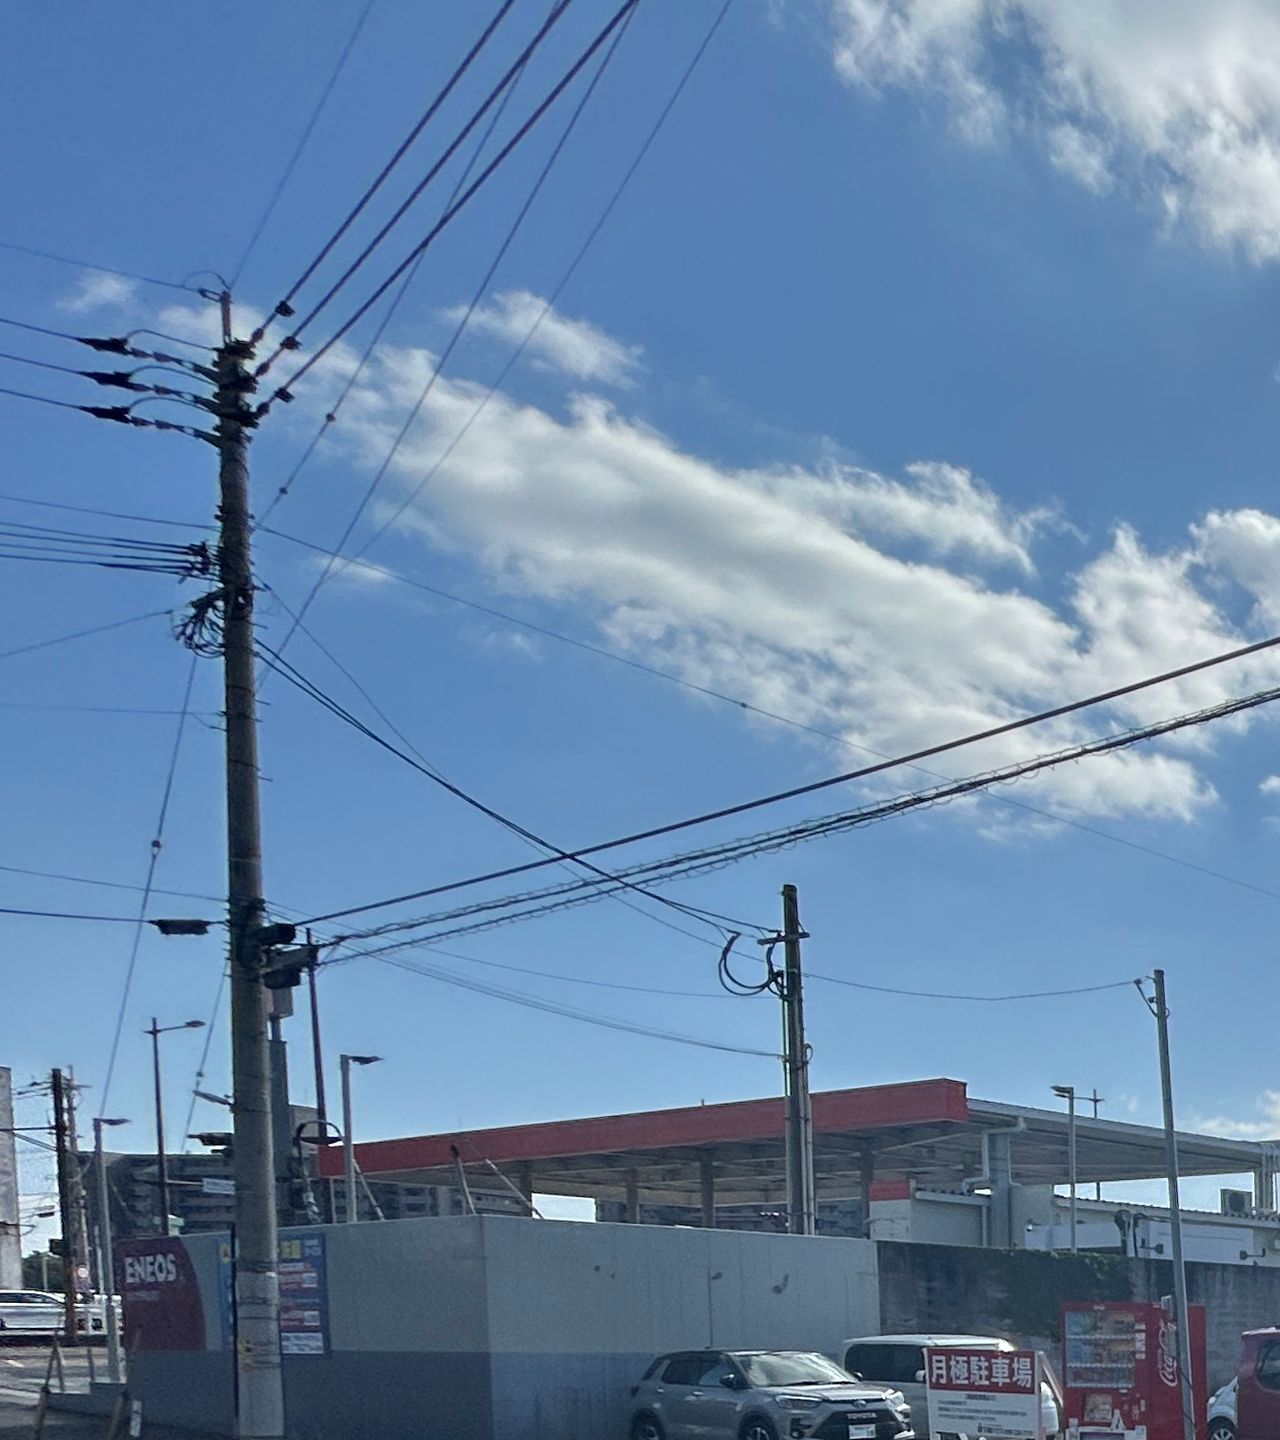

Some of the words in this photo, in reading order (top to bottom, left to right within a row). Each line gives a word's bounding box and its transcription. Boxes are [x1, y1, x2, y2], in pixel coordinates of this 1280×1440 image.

[124, 1253, 177, 1283] ENEOS
[931, 1354, 1034, 1389] 月極駐車場
